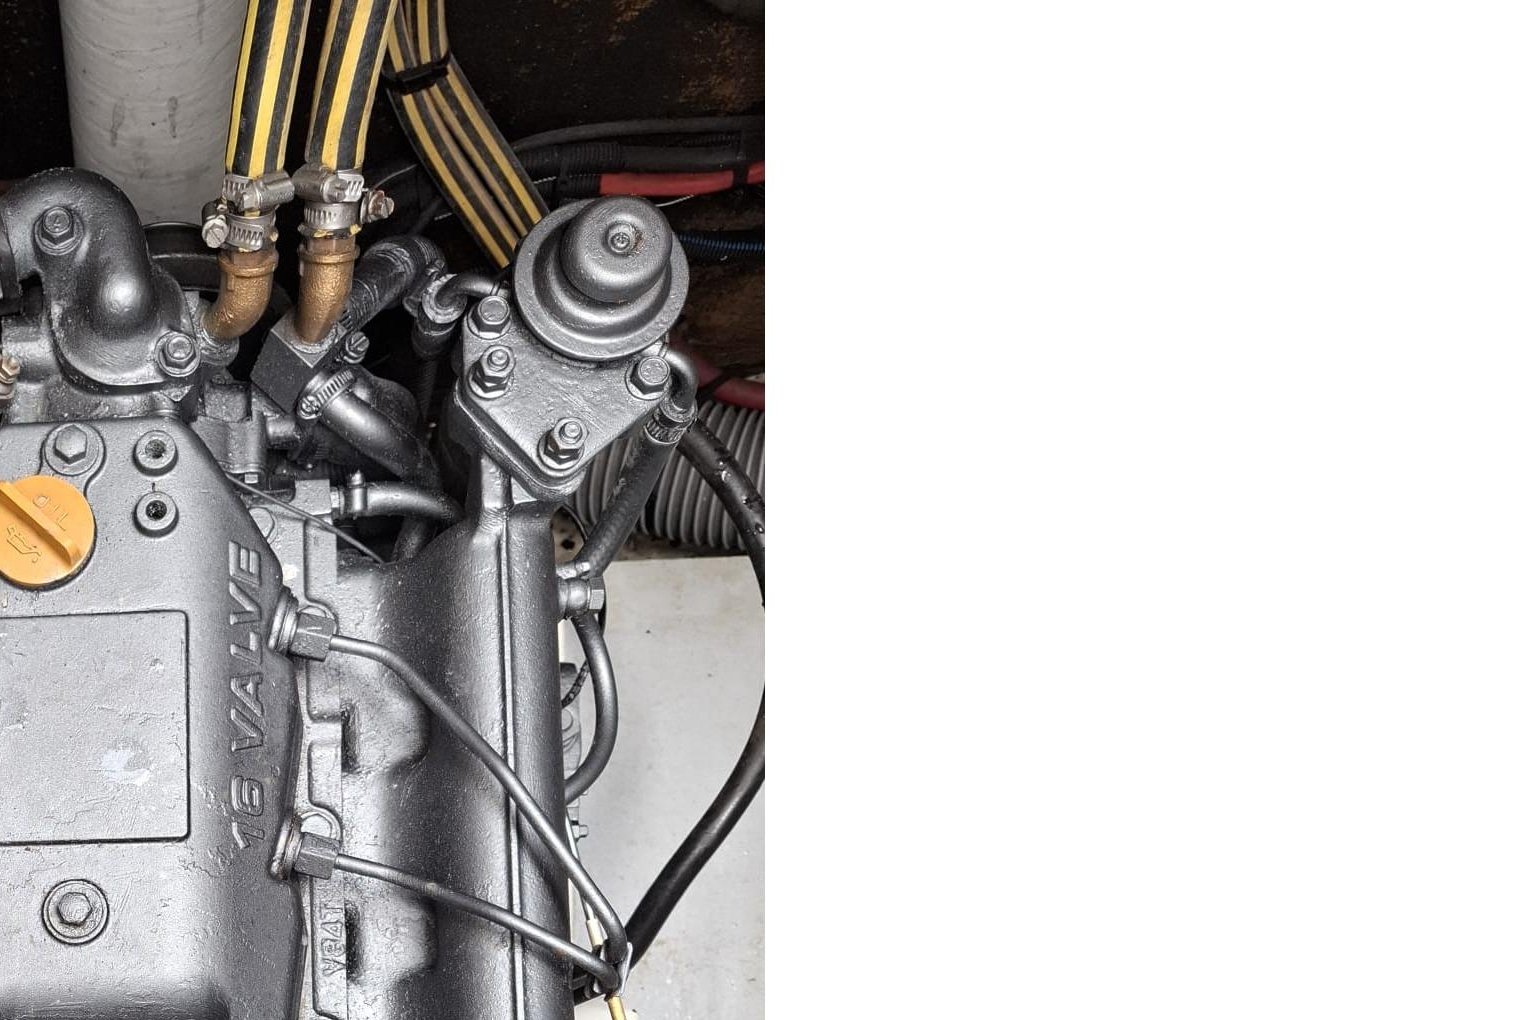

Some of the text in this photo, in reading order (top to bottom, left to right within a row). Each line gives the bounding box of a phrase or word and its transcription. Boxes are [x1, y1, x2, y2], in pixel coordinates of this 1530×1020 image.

[33, 495, 69, 532] OIL
[228, 540, 265, 850] 16 VALVE
